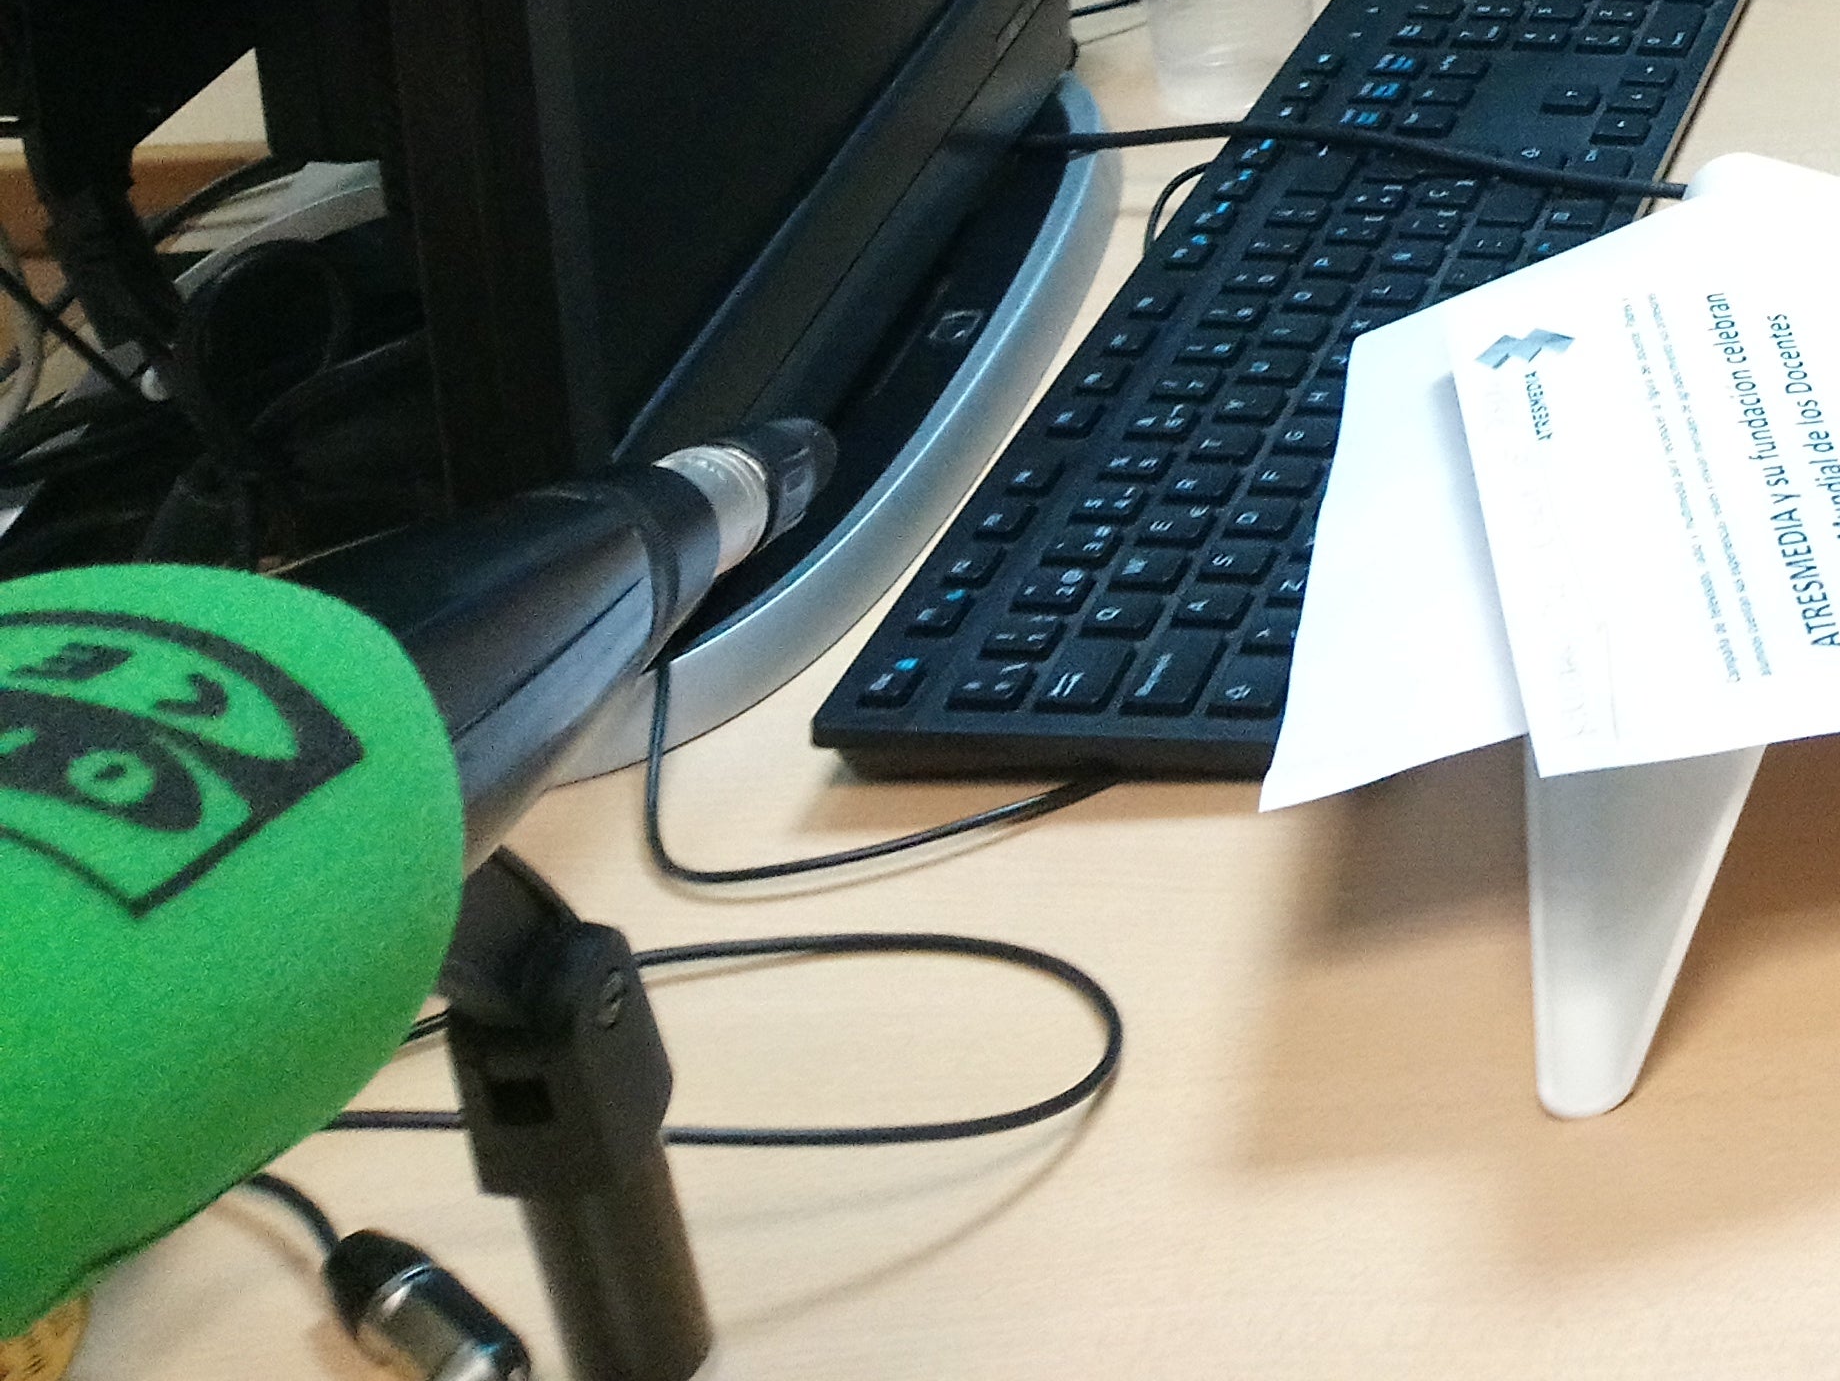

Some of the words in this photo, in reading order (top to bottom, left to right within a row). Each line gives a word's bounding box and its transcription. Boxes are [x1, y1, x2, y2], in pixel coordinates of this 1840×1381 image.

[1707, 293, 1747, 364] celebran
[1767, 314, 1812, 394] Docentes
[1525, 370, 1553, 441] ATRESMEDIA
[1727, 369, 1779, 460] fundación
[1796, 400, 1824, 425] los
[1802, 430, 1834, 453] de
[1762, 465, 1790, 487] su
[1770, 493, 1801, 504] y
